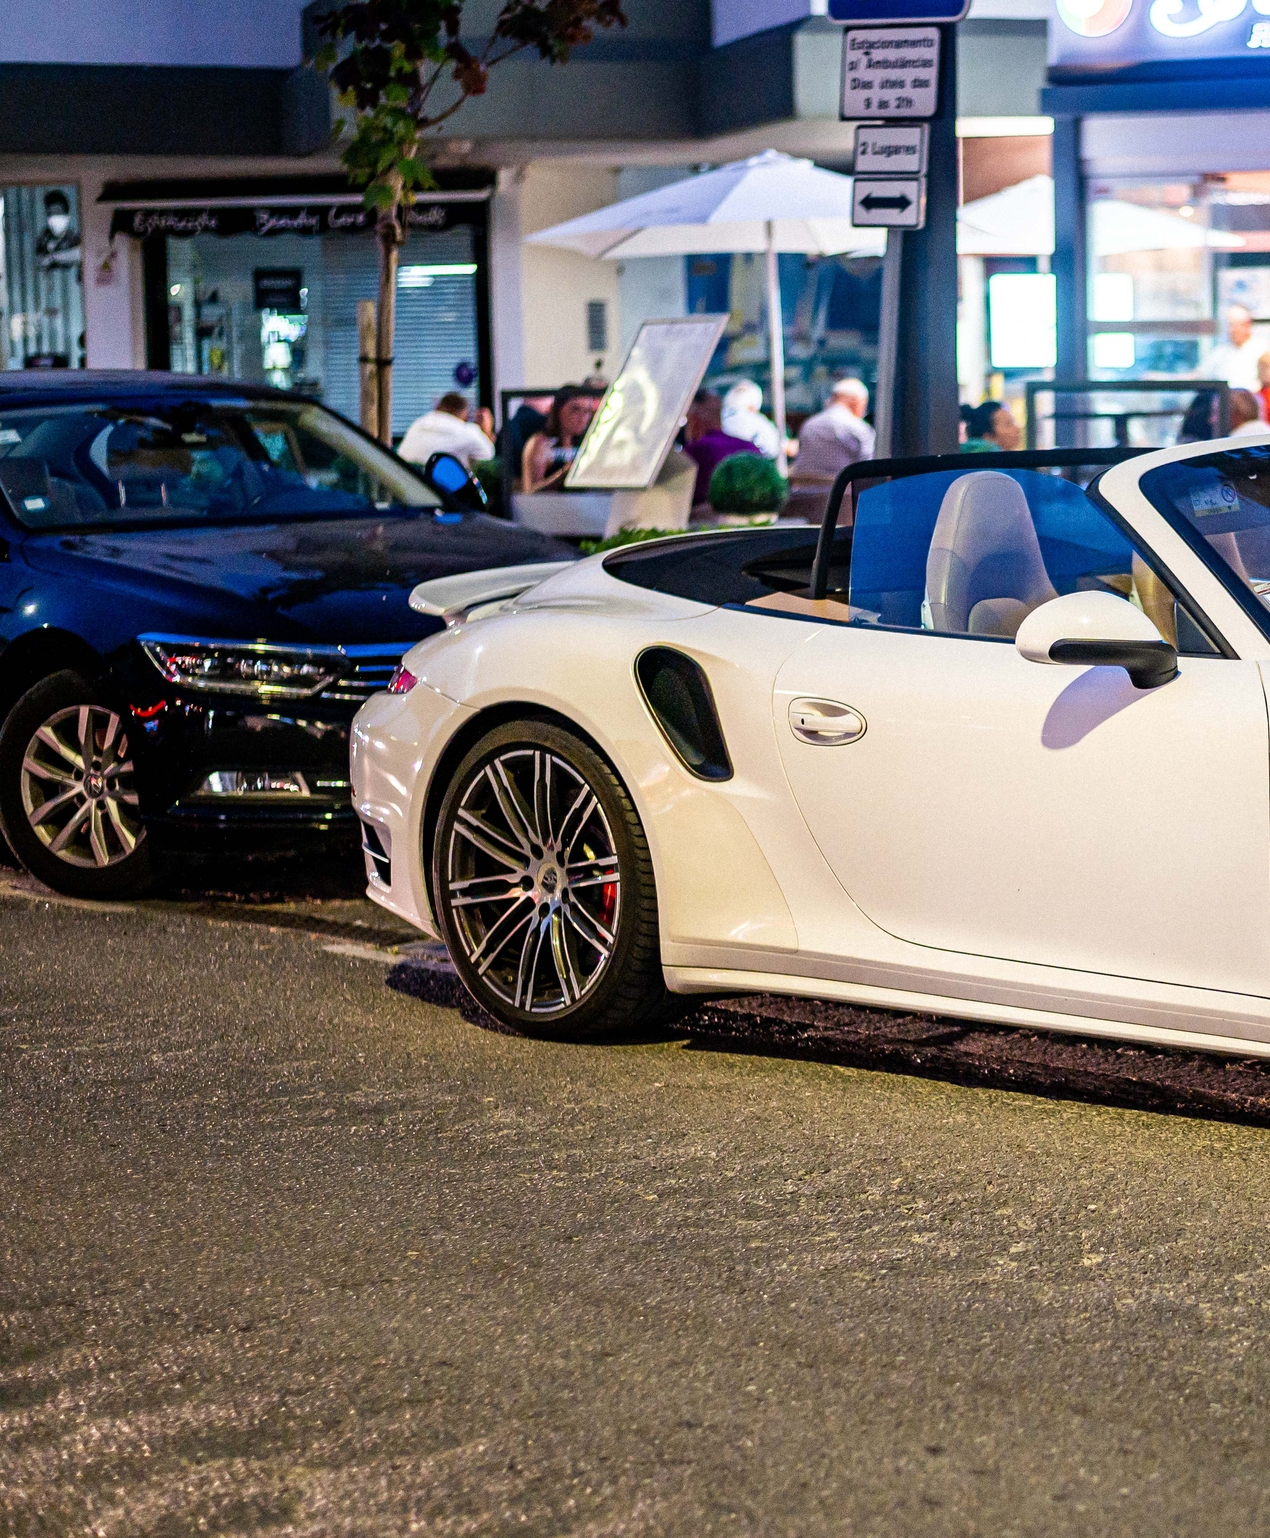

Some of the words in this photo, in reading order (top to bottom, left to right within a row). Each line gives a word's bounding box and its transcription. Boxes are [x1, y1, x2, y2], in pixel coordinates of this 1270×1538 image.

[849, 37, 934, 51] Estacionamento
[850, 77, 873, 90] Dias
[911, 76, 930, 89] das
[860, 141, 869, 155] 2
[871, 141, 917, 158] Lugares
